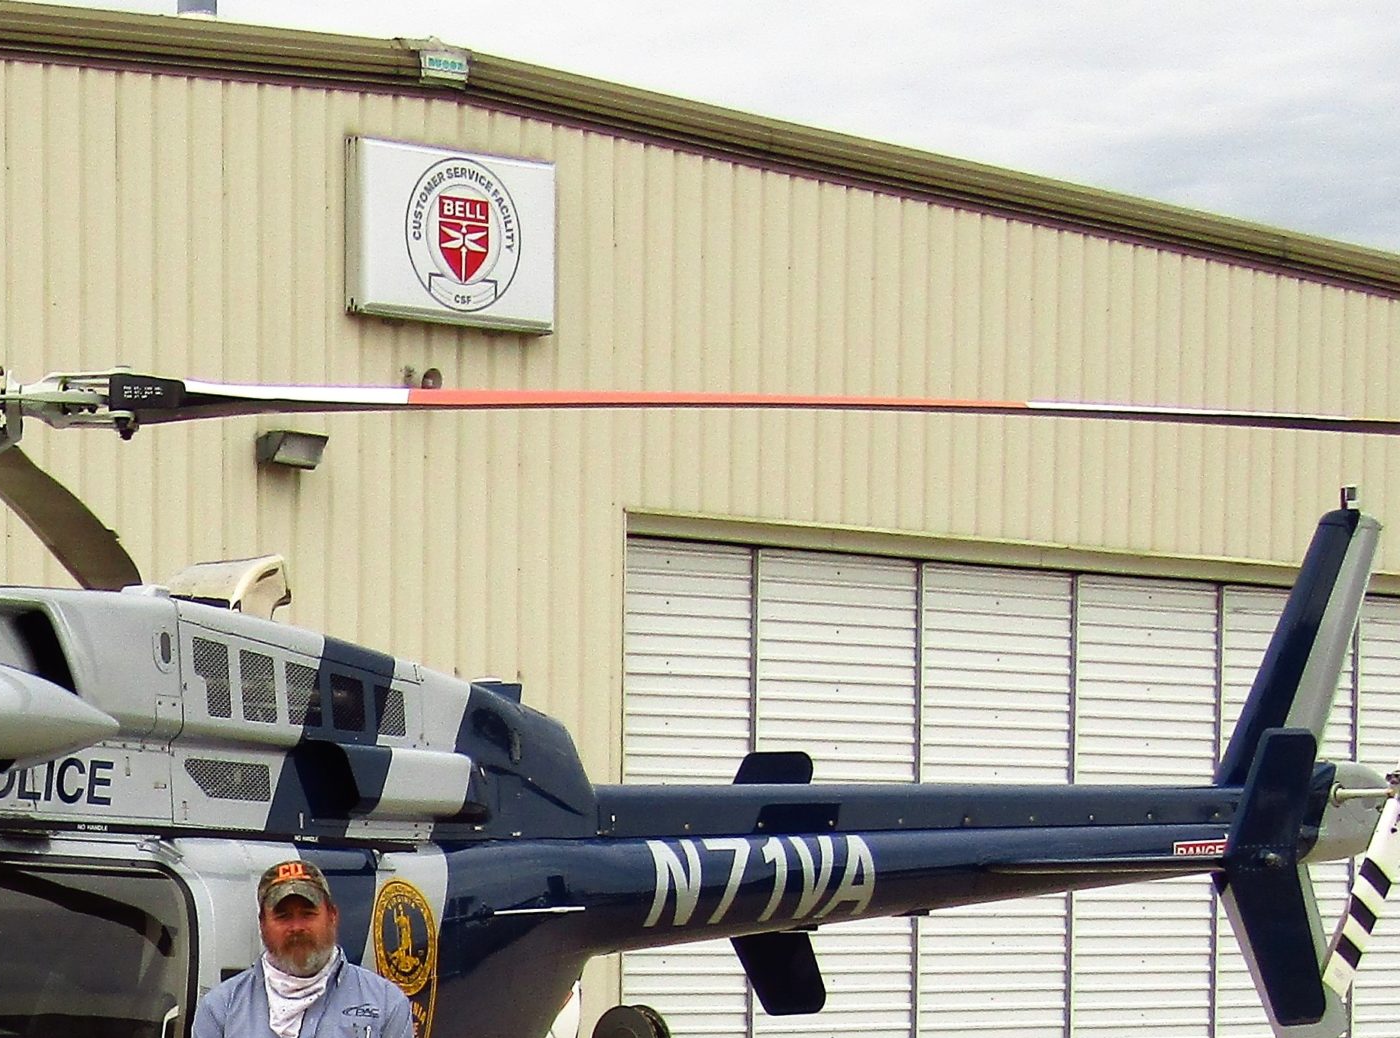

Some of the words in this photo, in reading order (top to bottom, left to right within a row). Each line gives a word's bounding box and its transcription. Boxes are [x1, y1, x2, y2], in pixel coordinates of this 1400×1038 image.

[412, 172, 446, 241] CUSTOMER
[446, 166, 493, 192] SERVICE
[491, 188, 515, 253] FACILITY
[442, 199, 486, 220] BELL
[454, 294, 472, 305] CSF
[1177, 844, 1226, 856] DANGE
[643, 835, 876, 928] N71VA
